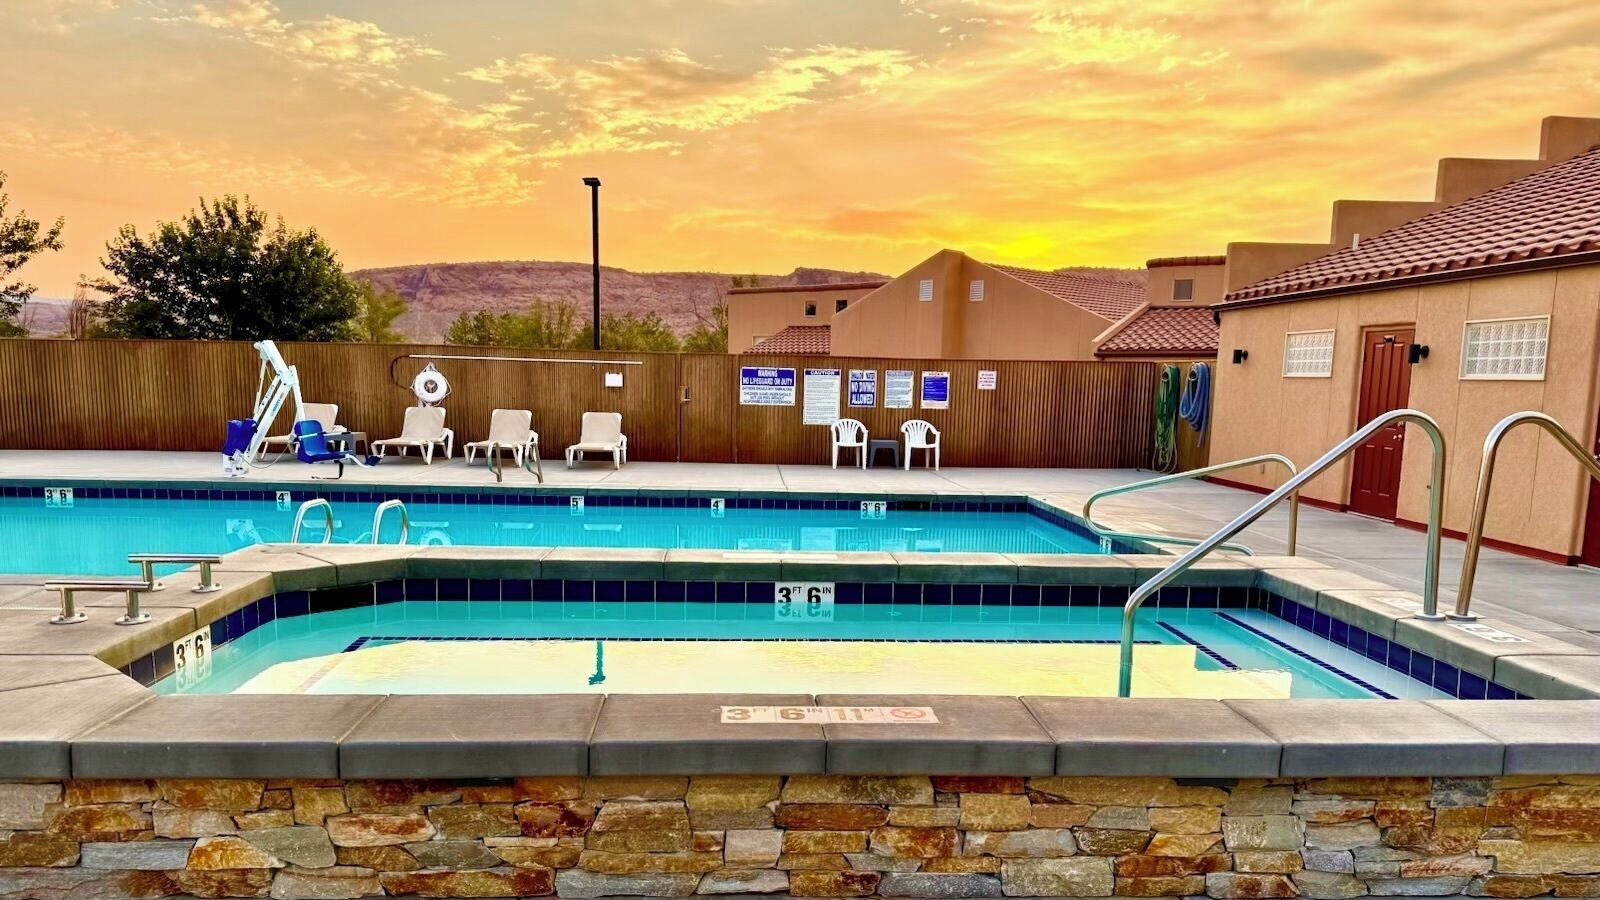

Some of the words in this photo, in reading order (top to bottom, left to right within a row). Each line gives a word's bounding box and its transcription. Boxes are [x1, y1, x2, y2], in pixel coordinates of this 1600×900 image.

[750, 377, 773, 385] LIFEGUARD
[851, 382, 859, 392] NO
[859, 382, 875, 392] DIVING
[852, 393, 874, 404] ALLOWED
[46, 489, 52, 498] 3
[60, 490, 66, 498] 6
[278, 492, 284, 501] 4
[572, 498, 578, 506] 5
[713, 500, 719, 508] 4
[862, 502, 868, 511] 3
[875, 502, 880, 511] 6
[778, 586, 792, 603] 3
[807, 586, 821, 603] 6
[176, 644, 186, 670] 3
[185, 638, 192, 650] FT
[195, 634, 204, 658] 6
[203, 630, 209, 640] IN
[726, 708, 750, 720] 3
[780, 708, 806, 720] 6
